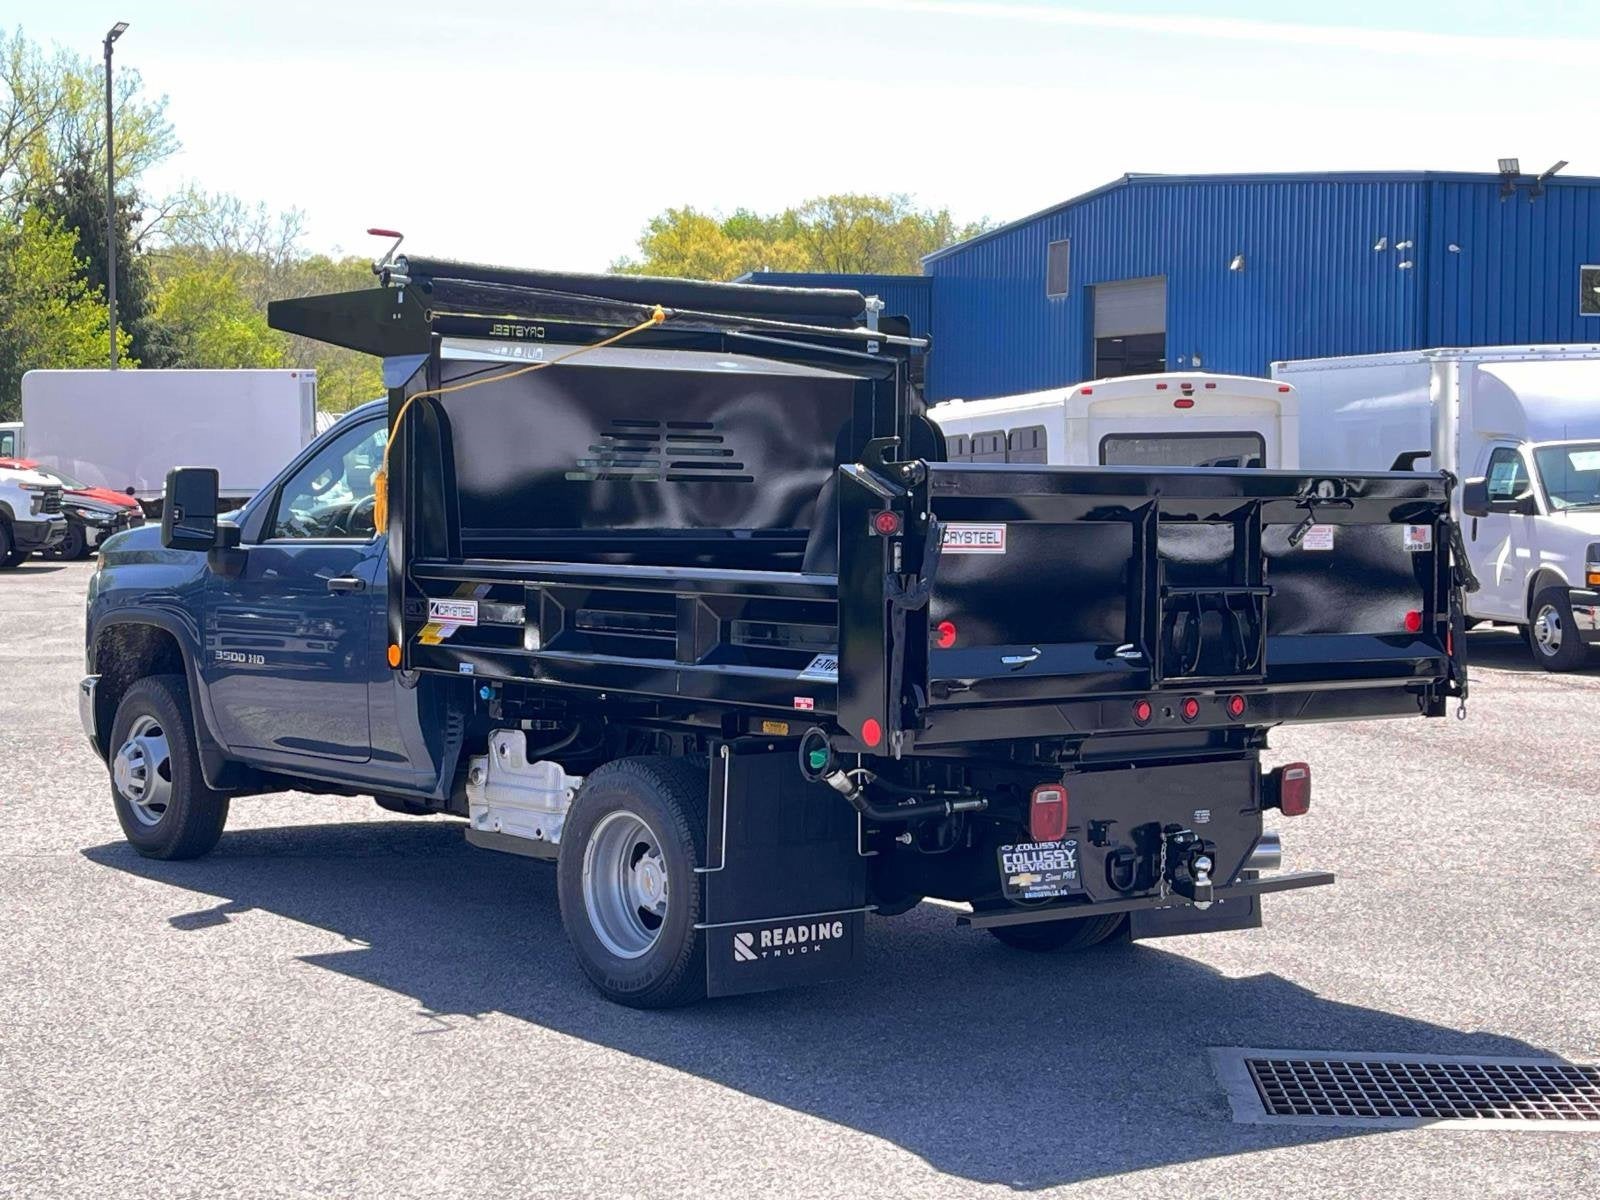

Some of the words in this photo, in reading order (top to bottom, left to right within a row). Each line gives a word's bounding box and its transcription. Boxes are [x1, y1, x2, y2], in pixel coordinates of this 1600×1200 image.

[215, 650, 246, 663] 3500
[248, 653, 265, 665] HD
[1018, 841, 1061, 852] COLUSSY
[1003, 848, 1076, 865] COLUSSY
[1004, 859, 1076, 874] CHEVROLET
[760, 921, 843, 948] READING
[761, 944, 821, 958] TRUCK
